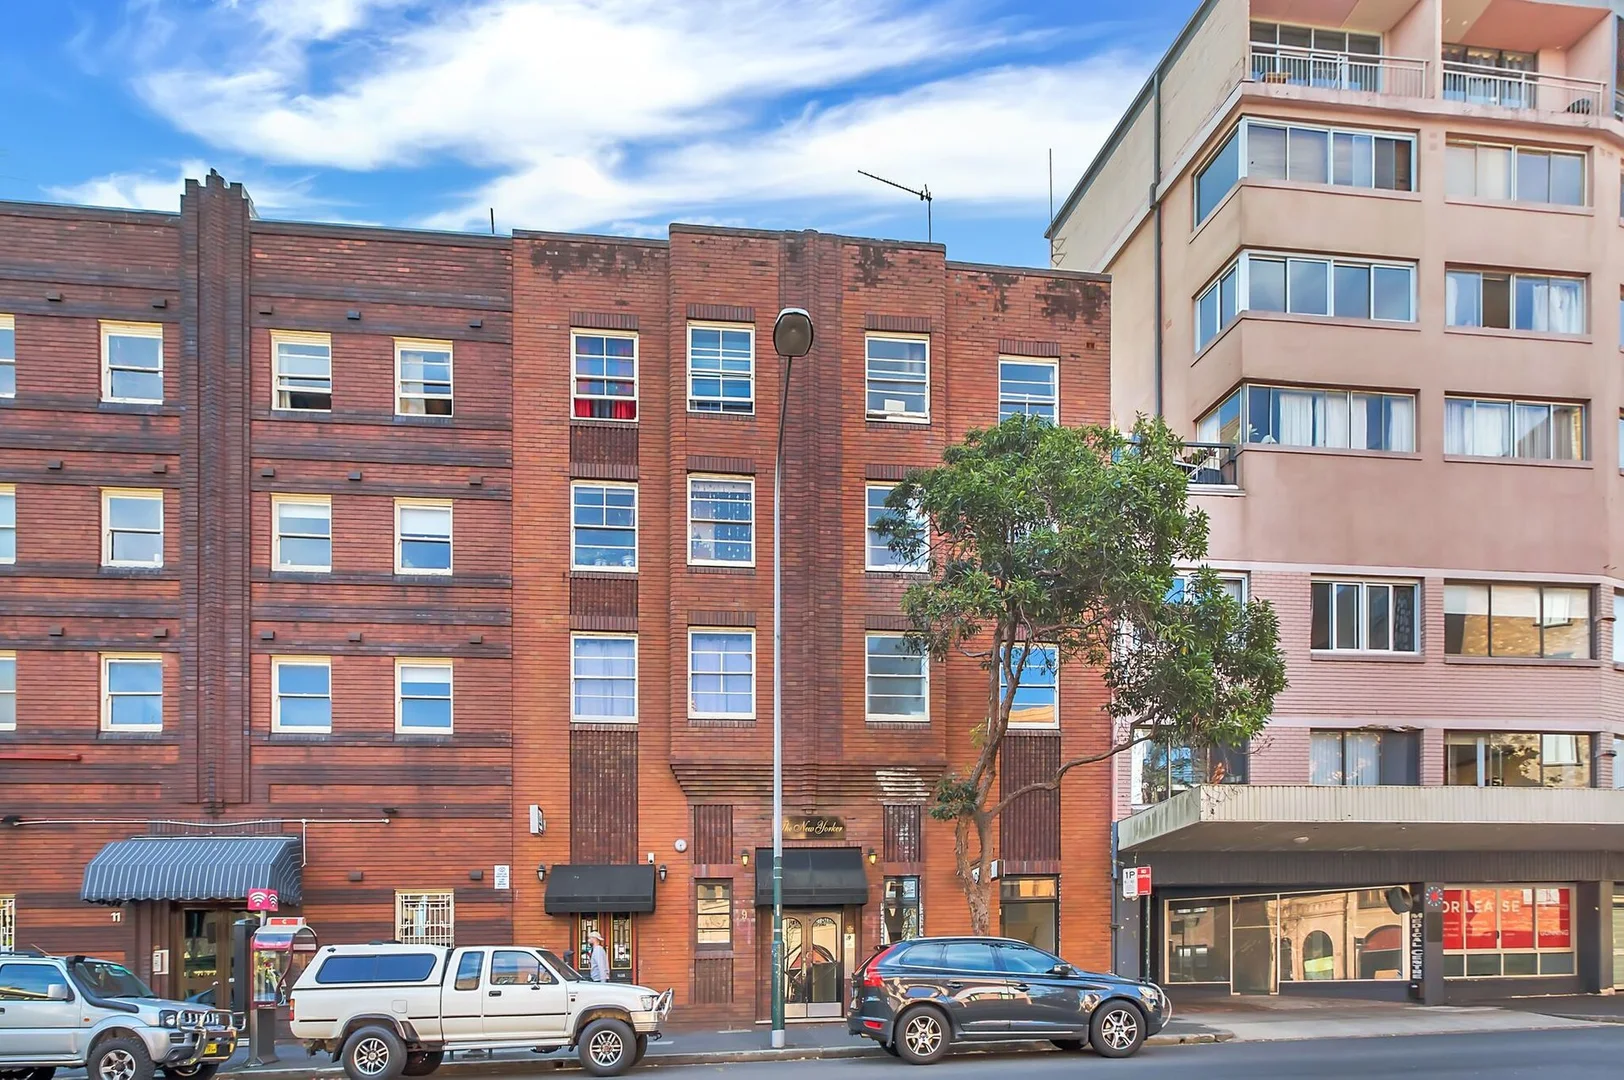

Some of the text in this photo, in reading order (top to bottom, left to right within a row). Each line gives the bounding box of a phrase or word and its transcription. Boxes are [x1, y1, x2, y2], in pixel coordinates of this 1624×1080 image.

[782, 820, 843, 834] The New Yorker
[1125, 871, 1136, 879] 1P
[1442, 900, 1520, 913] OR LEASE
[110, 912, 121, 922] 11
[741, 910, 748, 920] 9
